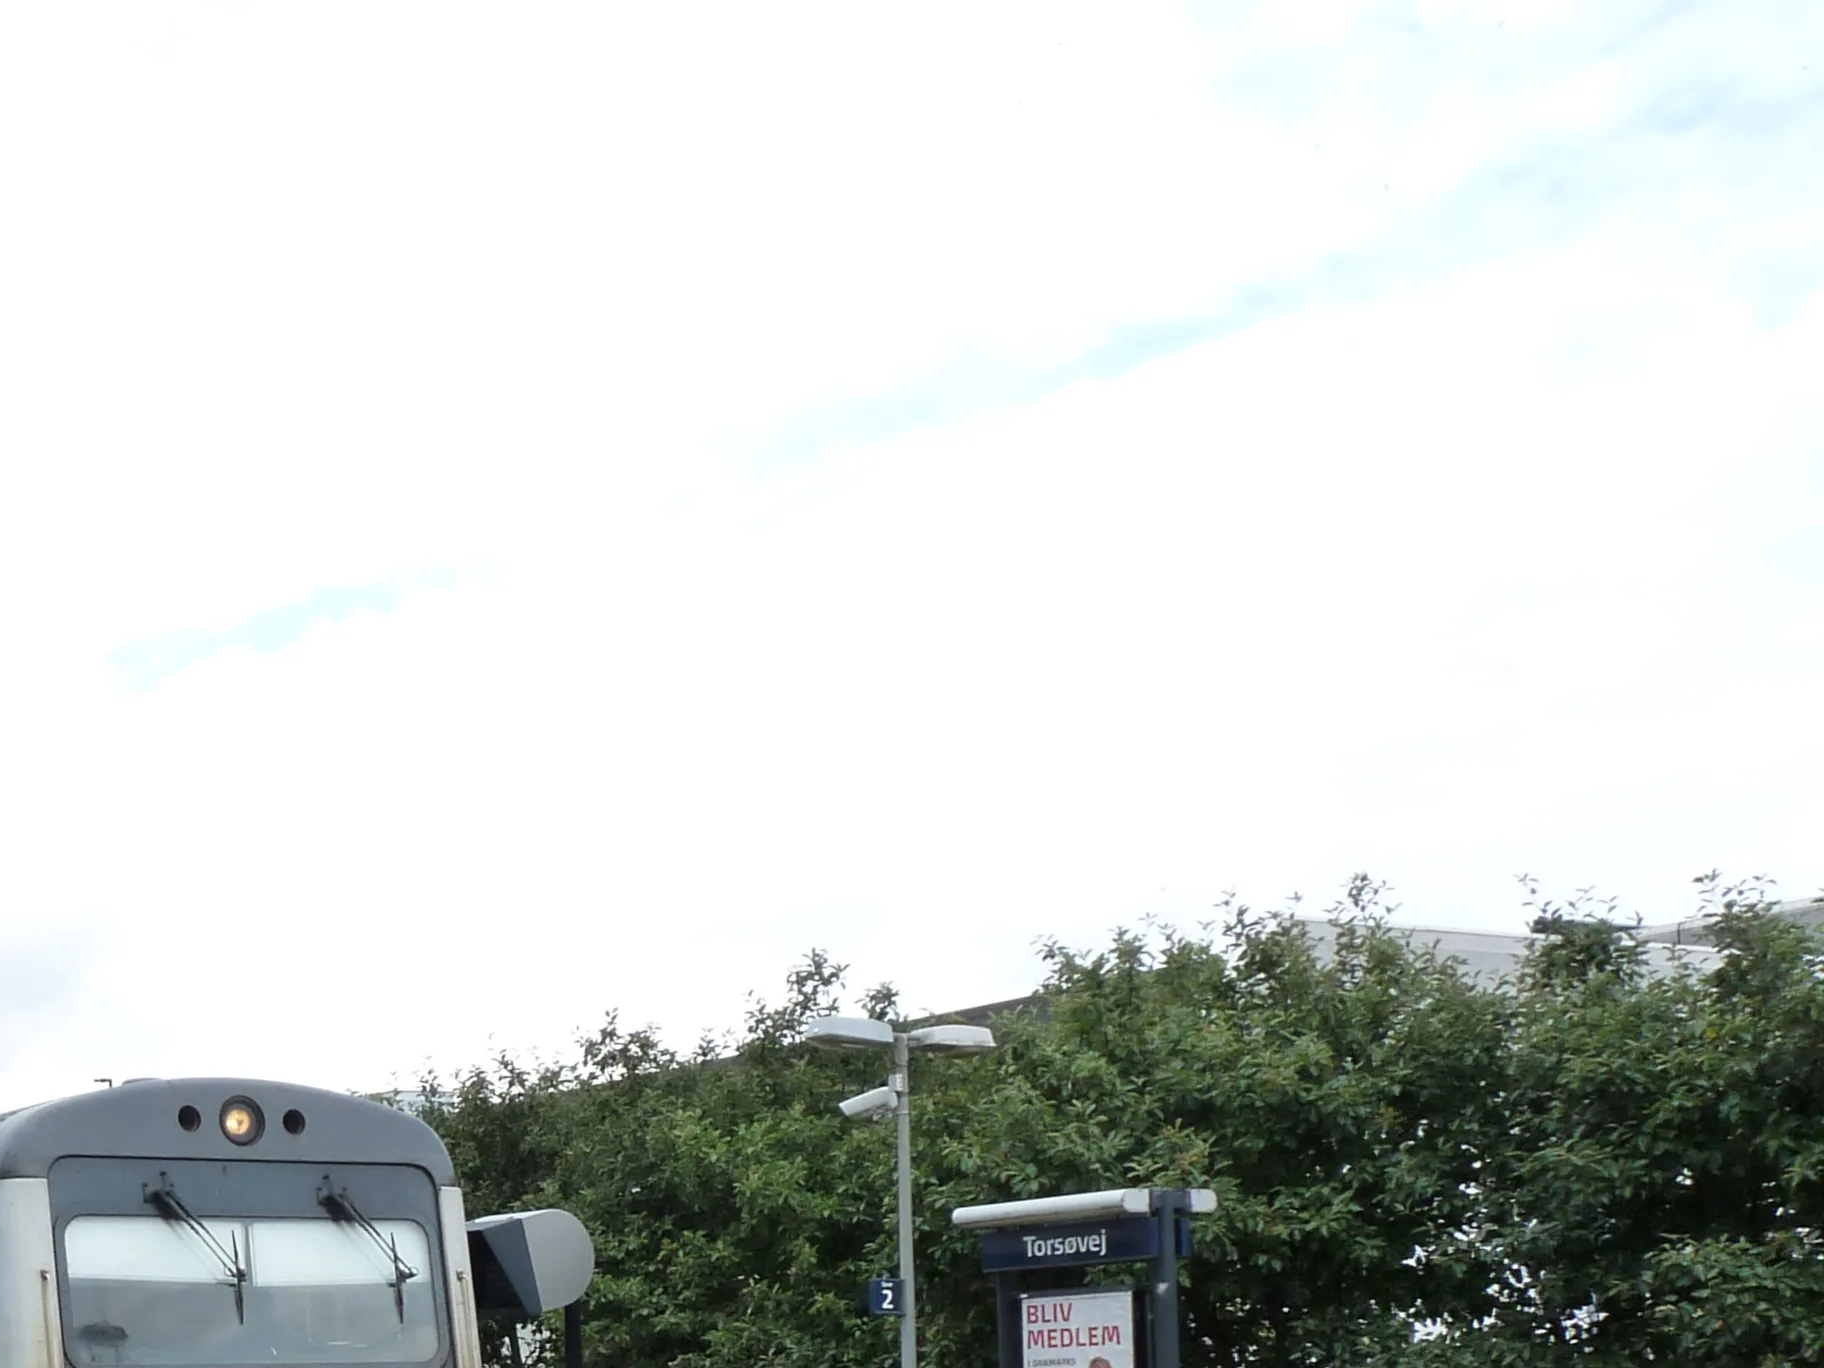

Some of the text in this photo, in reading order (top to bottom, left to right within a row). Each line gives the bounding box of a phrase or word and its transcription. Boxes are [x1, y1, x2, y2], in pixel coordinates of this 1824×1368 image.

[1023, 1228, 1107, 1258] Torsøvej
[881, 1289, 894, 1310] 2
[1026, 1302, 1073, 1325] BLIV
[1027, 1325, 1122, 1350] MEDLEM
